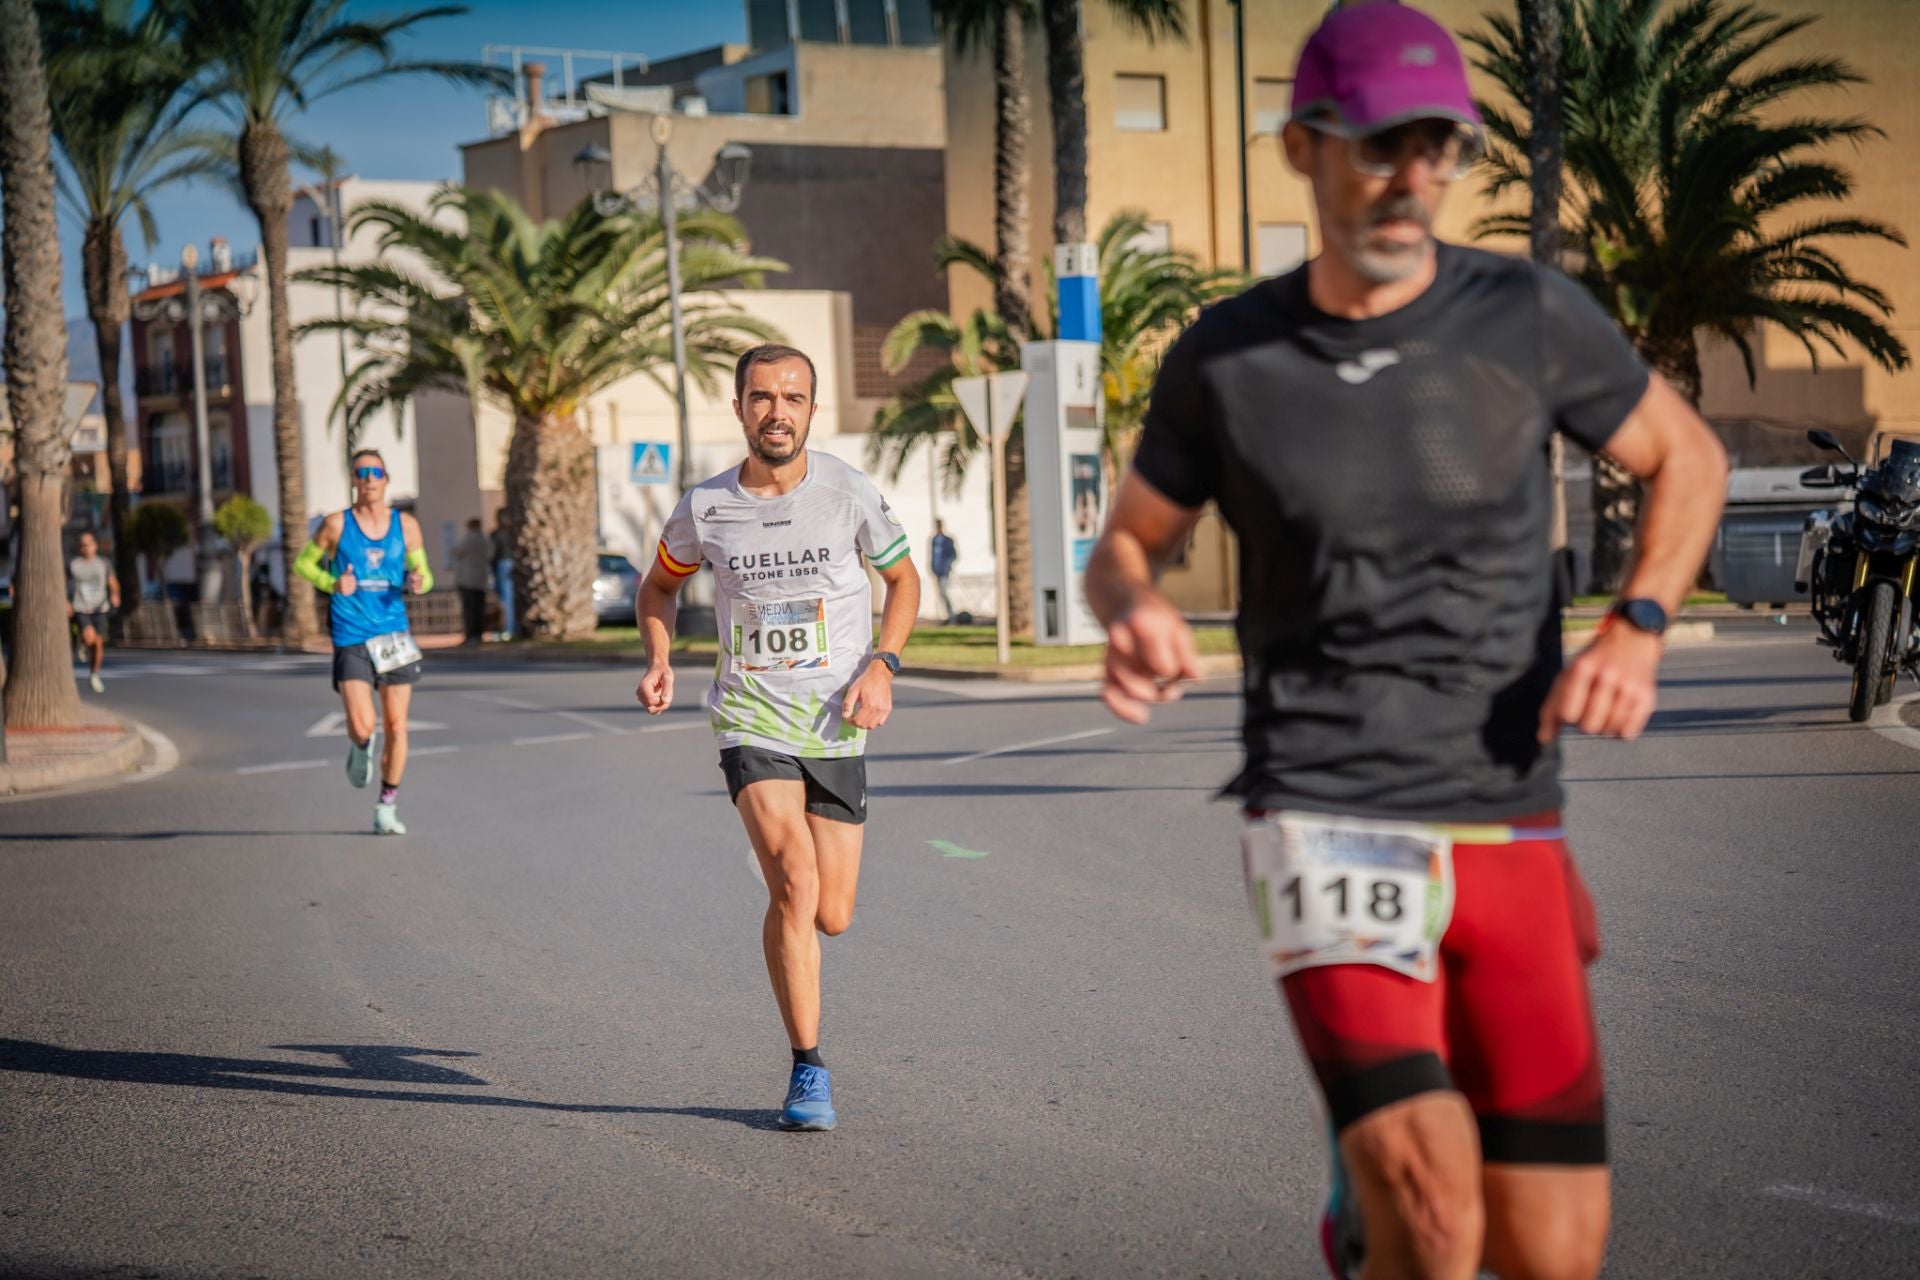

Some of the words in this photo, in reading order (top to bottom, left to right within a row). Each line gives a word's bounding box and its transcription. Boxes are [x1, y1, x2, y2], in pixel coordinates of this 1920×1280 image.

[729, 548, 831, 571] CUELLAR
[743, 570, 783, 582] STONE
[789, 567, 818, 577] 1958
[758, 602, 793, 618] MEDIA
[748, 627, 808, 654] 108
[1280, 876, 1403, 922] 118
